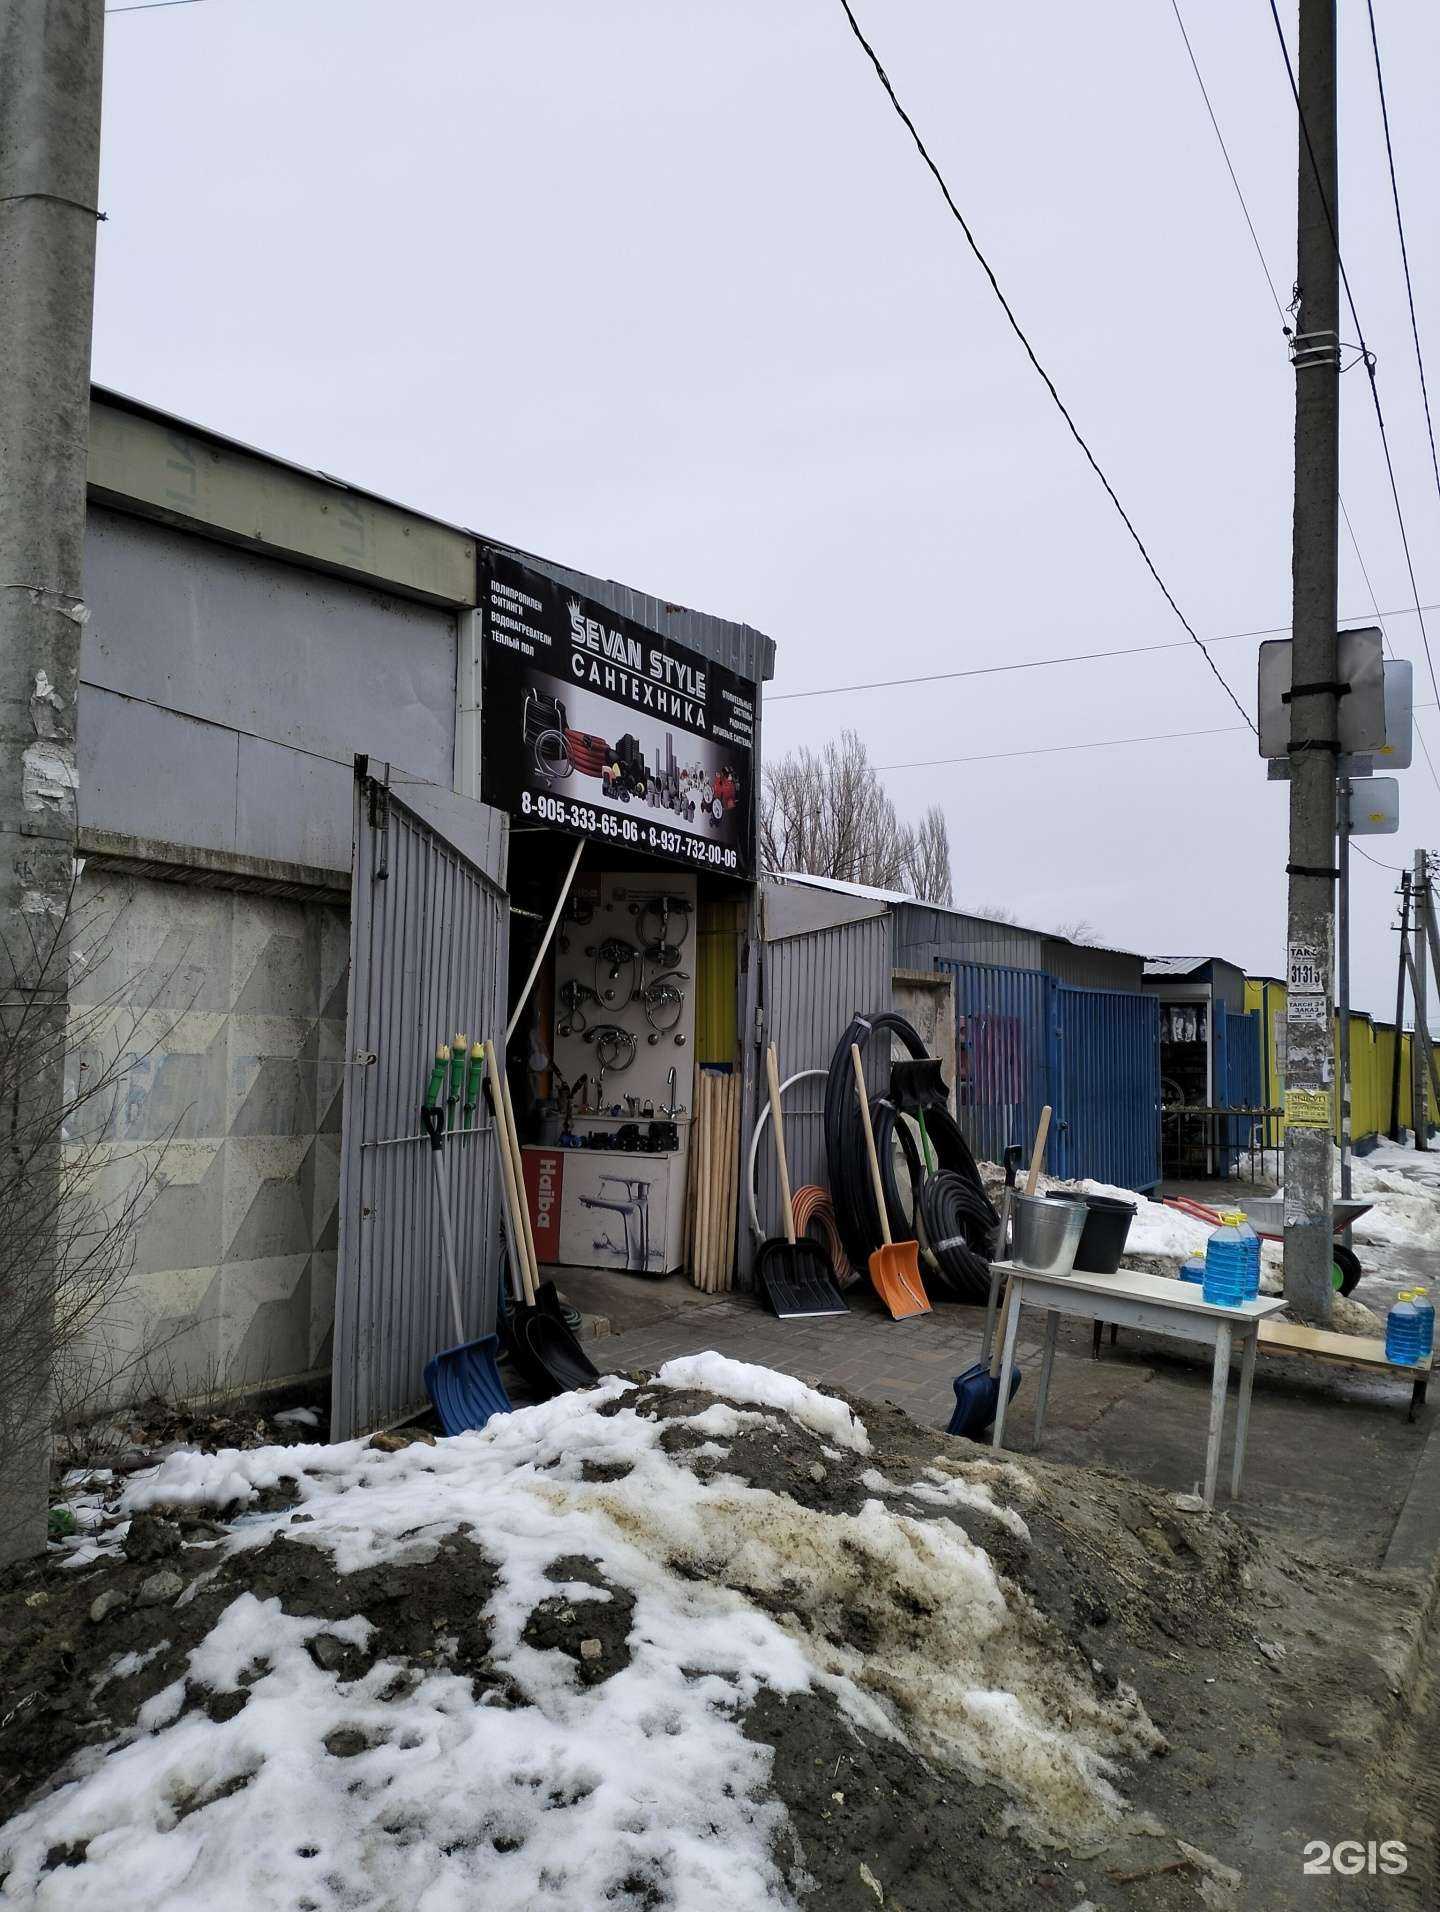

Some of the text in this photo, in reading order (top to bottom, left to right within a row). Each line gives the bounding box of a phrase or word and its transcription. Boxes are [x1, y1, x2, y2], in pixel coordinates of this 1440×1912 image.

[490, 594, 524, 617] ФИТИНГИ
[491, 580, 543, 612] ПОЛИПРОПИЛЕН
[491, 611, 552, 646] ВОДОНАГРЕВАТЕЛИ
[520, 641, 535, 657] ПОЛ
[570, 615, 706, 701] SEVAN STYLE
[571, 653, 706, 730] САНТЕХНИКА
[521, 791, 737, 868] 8-905-333-65-06 8-937-732-00-06
[537, 1159, 557, 1228] Haiba
